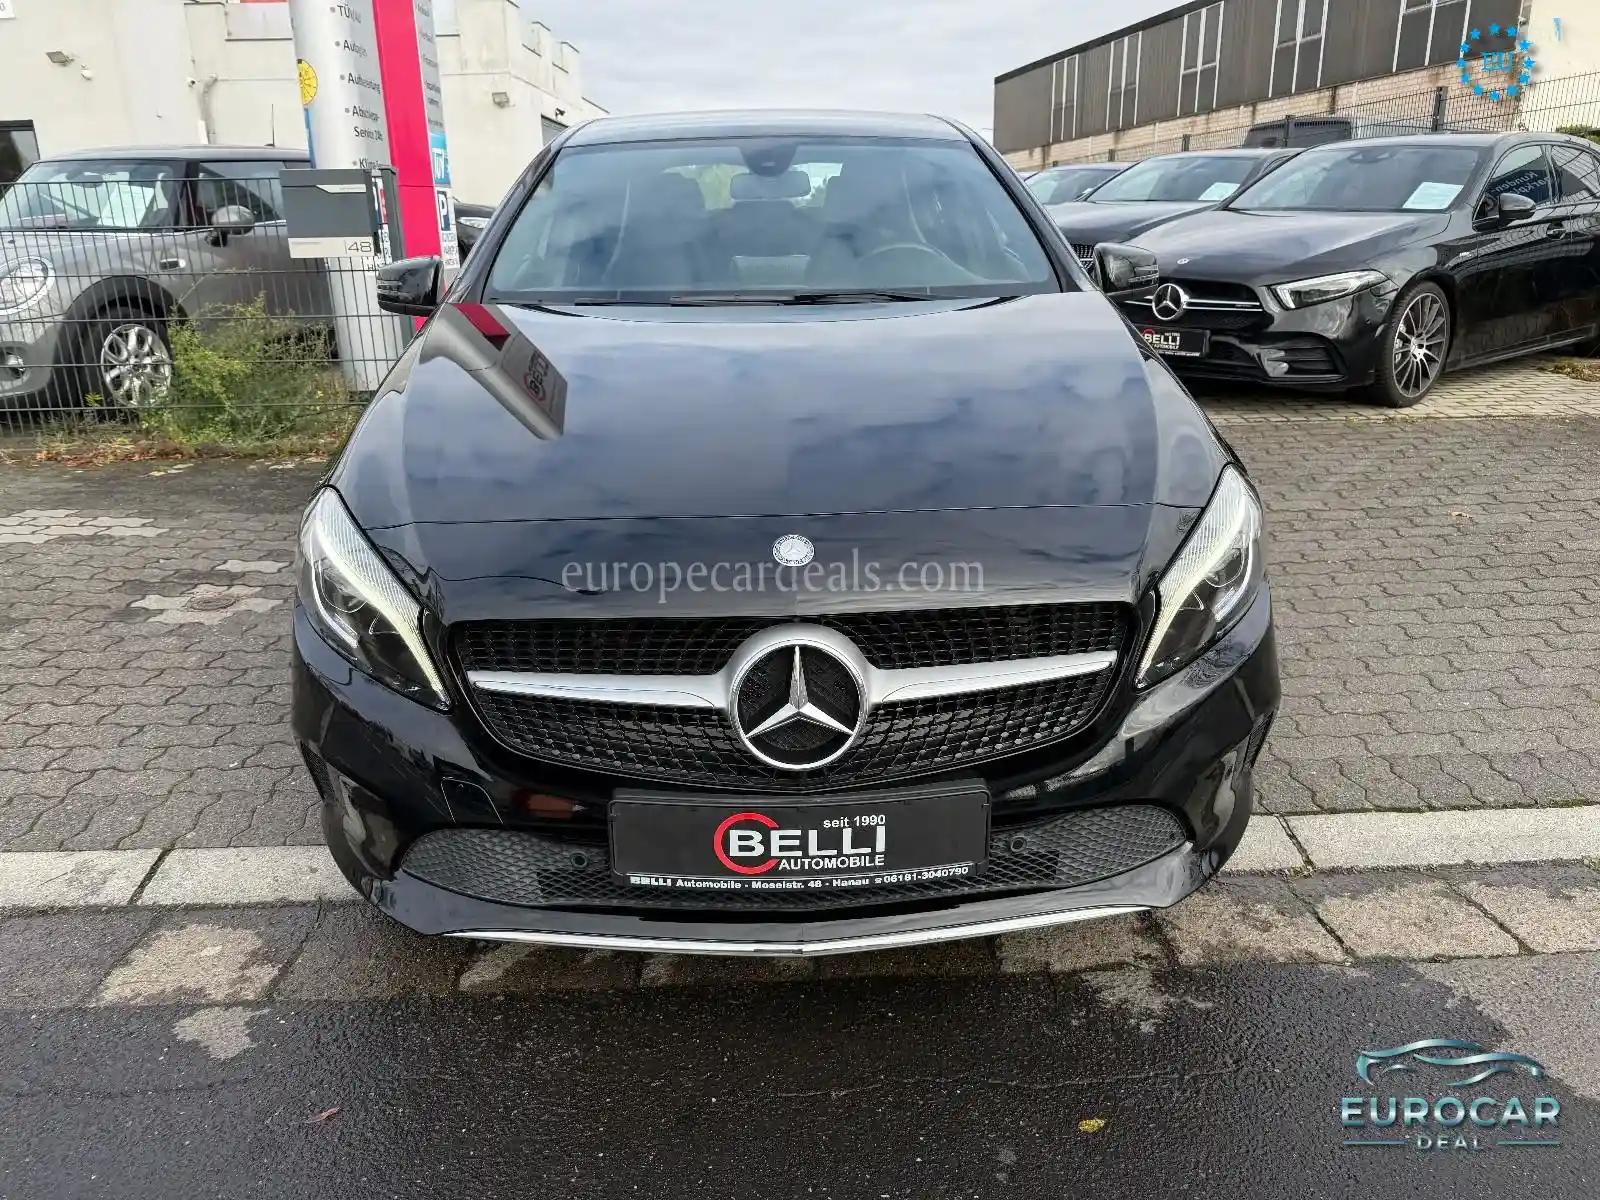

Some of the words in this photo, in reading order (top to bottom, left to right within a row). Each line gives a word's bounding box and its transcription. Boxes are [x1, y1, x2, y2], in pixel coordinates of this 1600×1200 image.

[348, 241, 372, 252] 48
[1144, 333, 1180, 345] BELLI
[823, 817, 850, 828] seit
[854, 814, 886, 826] 1990
[729, 826, 886, 857] BELLI
[778, 855, 885, 871] AUTOMOBILE
[630, 876, 671, 887] BELLI
[676, 879, 741, 889] Automobile
[751, 881, 804, 889] Moselstr.
[833, 878, 869, 887] Hanau
